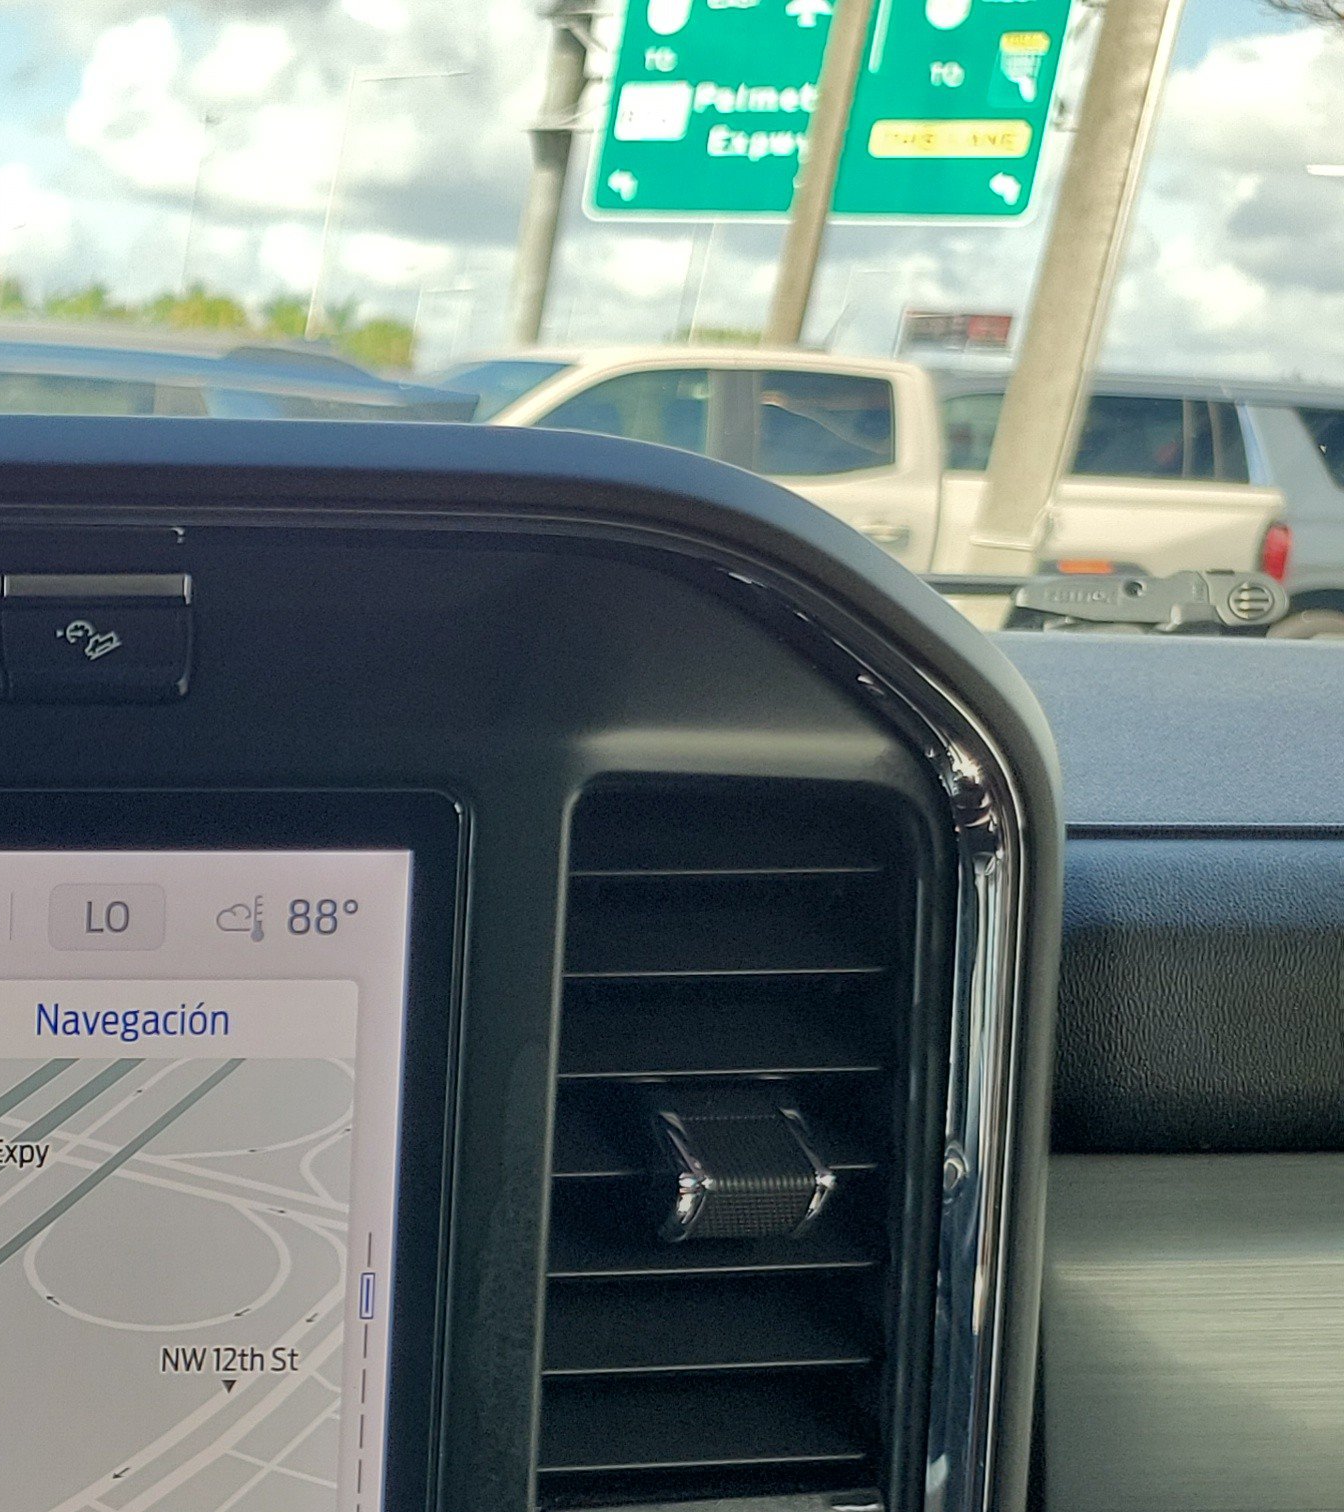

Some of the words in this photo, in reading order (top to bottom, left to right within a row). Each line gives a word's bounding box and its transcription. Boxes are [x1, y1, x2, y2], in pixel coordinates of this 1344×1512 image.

[694, 81, 820, 113] Palmet
[85, 900, 130, 933] LO
[286, 898, 359, 935] 88°
[36, 1002, 230, 1042] Navegación
[160, 1347, 206, 1372] NW
[213, 1347, 264, 1372] 12th
[270, 1347, 299, 1372] St
